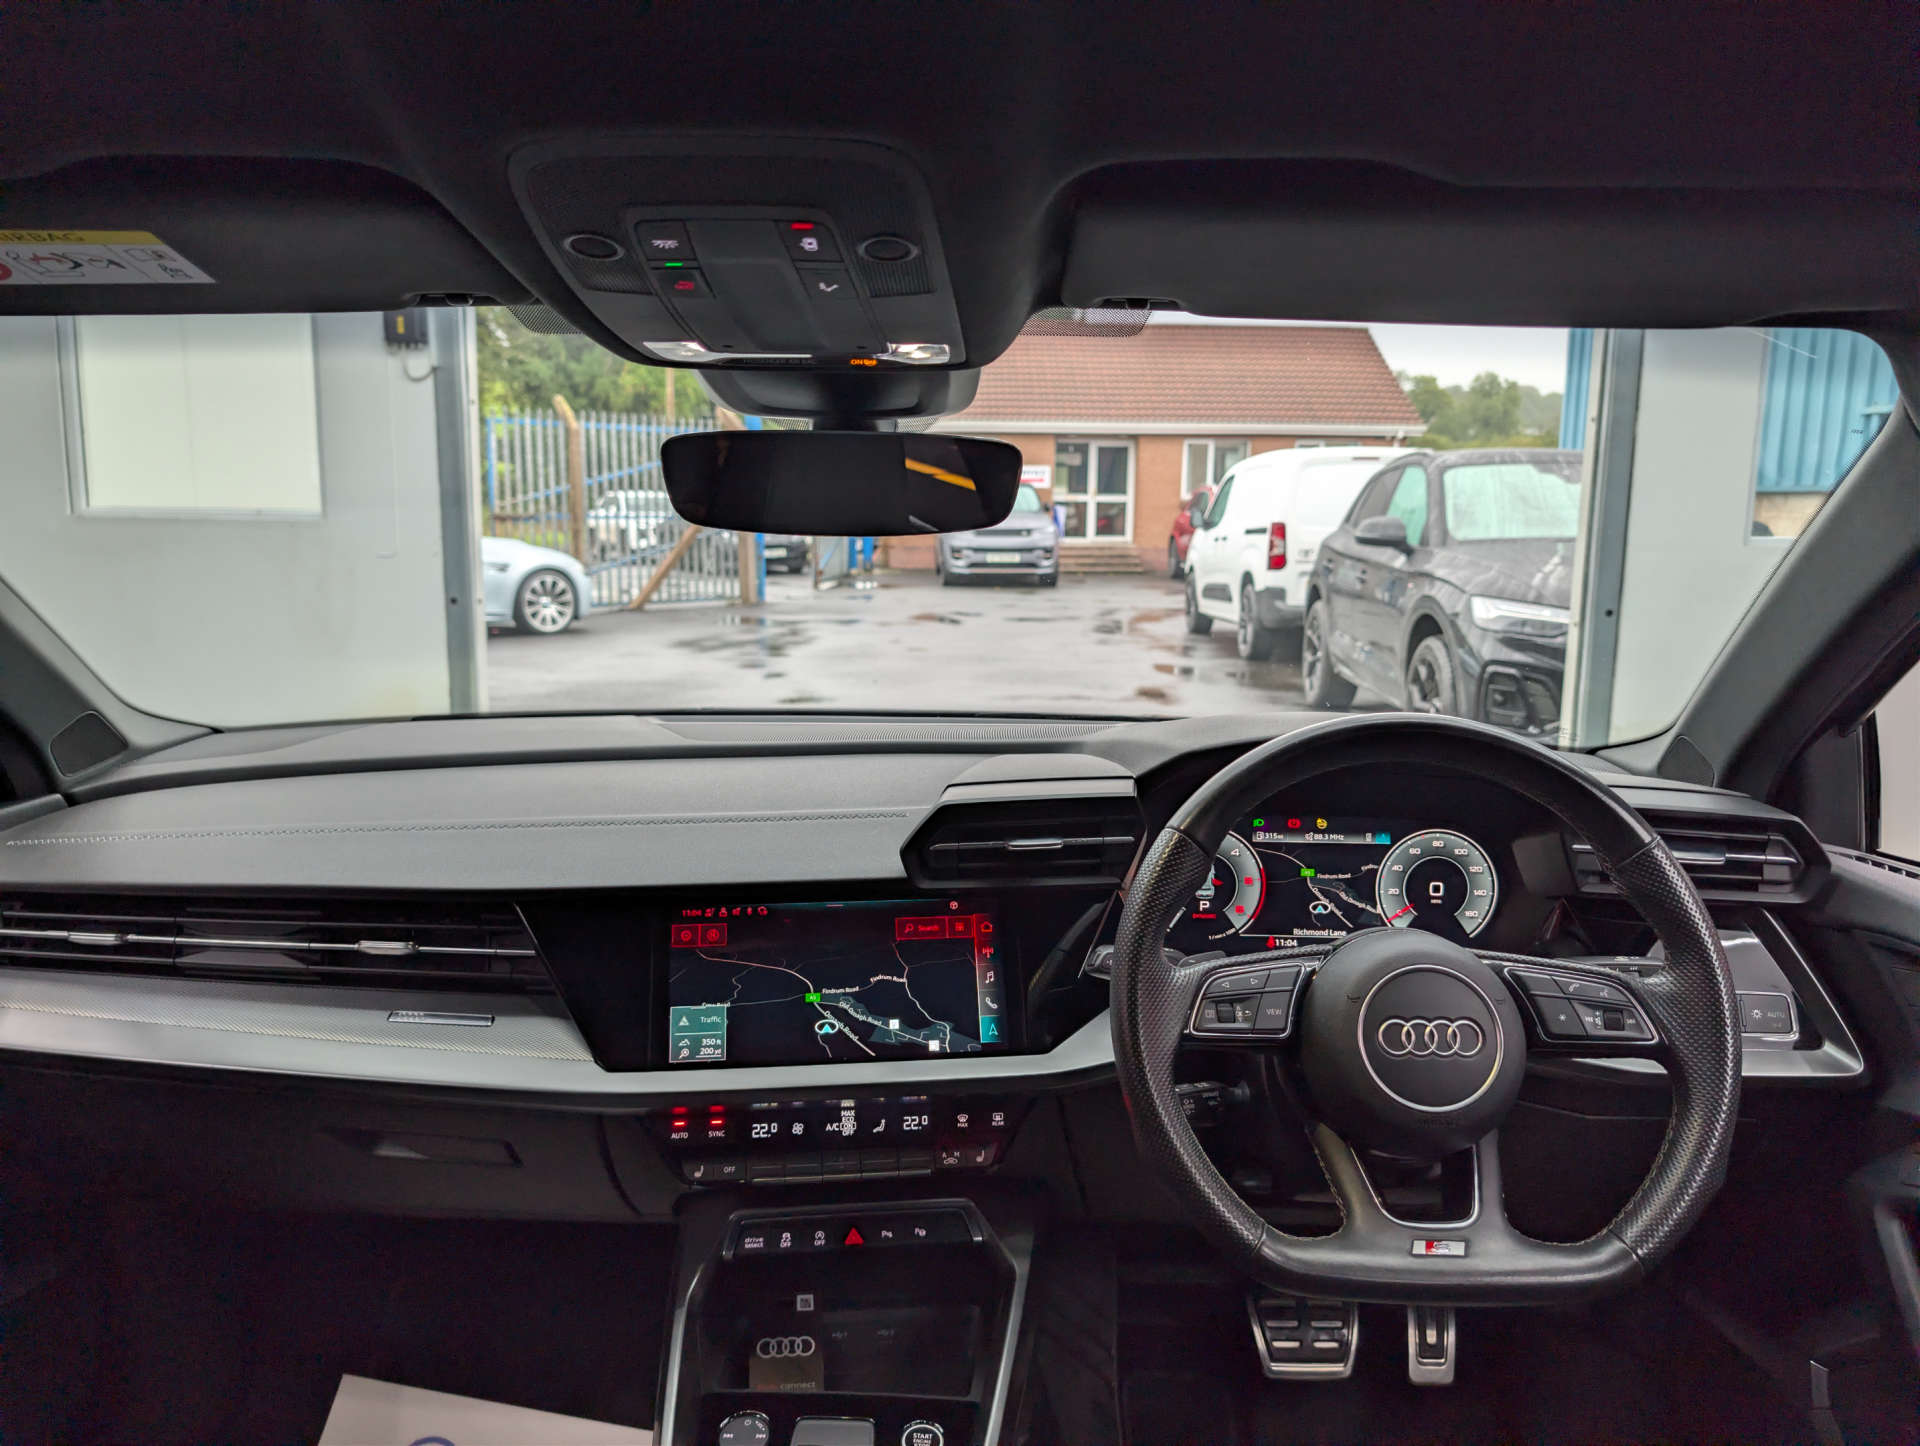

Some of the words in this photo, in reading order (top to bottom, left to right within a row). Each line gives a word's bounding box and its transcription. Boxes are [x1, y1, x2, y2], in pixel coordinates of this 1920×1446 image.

[1429, 882, 1443, 896] 0
[1199, 901, 1210, 912] P
[1293, 928, 1329, 936] Richmond
[1275, 939, 1297, 947] 11:04
[867, 1016, 882, 1026] Road
[702, 1038, 716, 1046] 350
[699, 1047, 714, 1055] 200
[841, 1109, 855, 1117] MAX
[903, 1115, 928, 1130] 22.0
[752, 1122, 778, 1139] 22.0
[825, 1123, 839, 1131] A/C
[708, 1130, 725, 1138] SYNC
[723, 1166, 736, 1174] OFF
[912, 1432, 933, 1440] START
